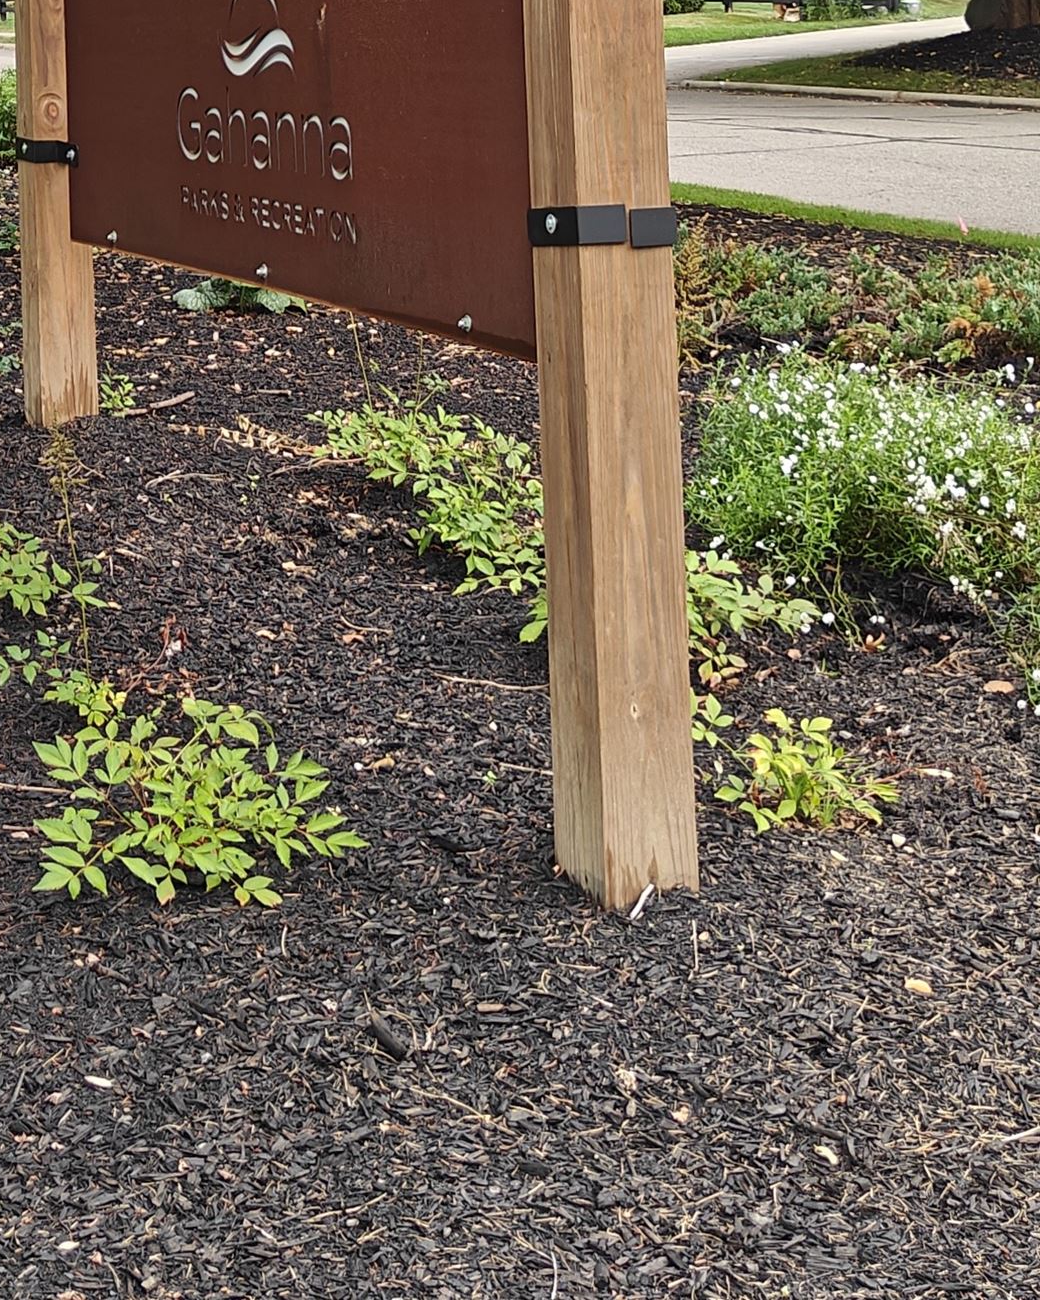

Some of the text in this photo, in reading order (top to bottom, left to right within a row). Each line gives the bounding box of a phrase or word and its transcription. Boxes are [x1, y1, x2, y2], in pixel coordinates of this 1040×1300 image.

[177, 86, 353, 180] Gahanna
[180, 185, 358, 245] PARKS & RECREATON
